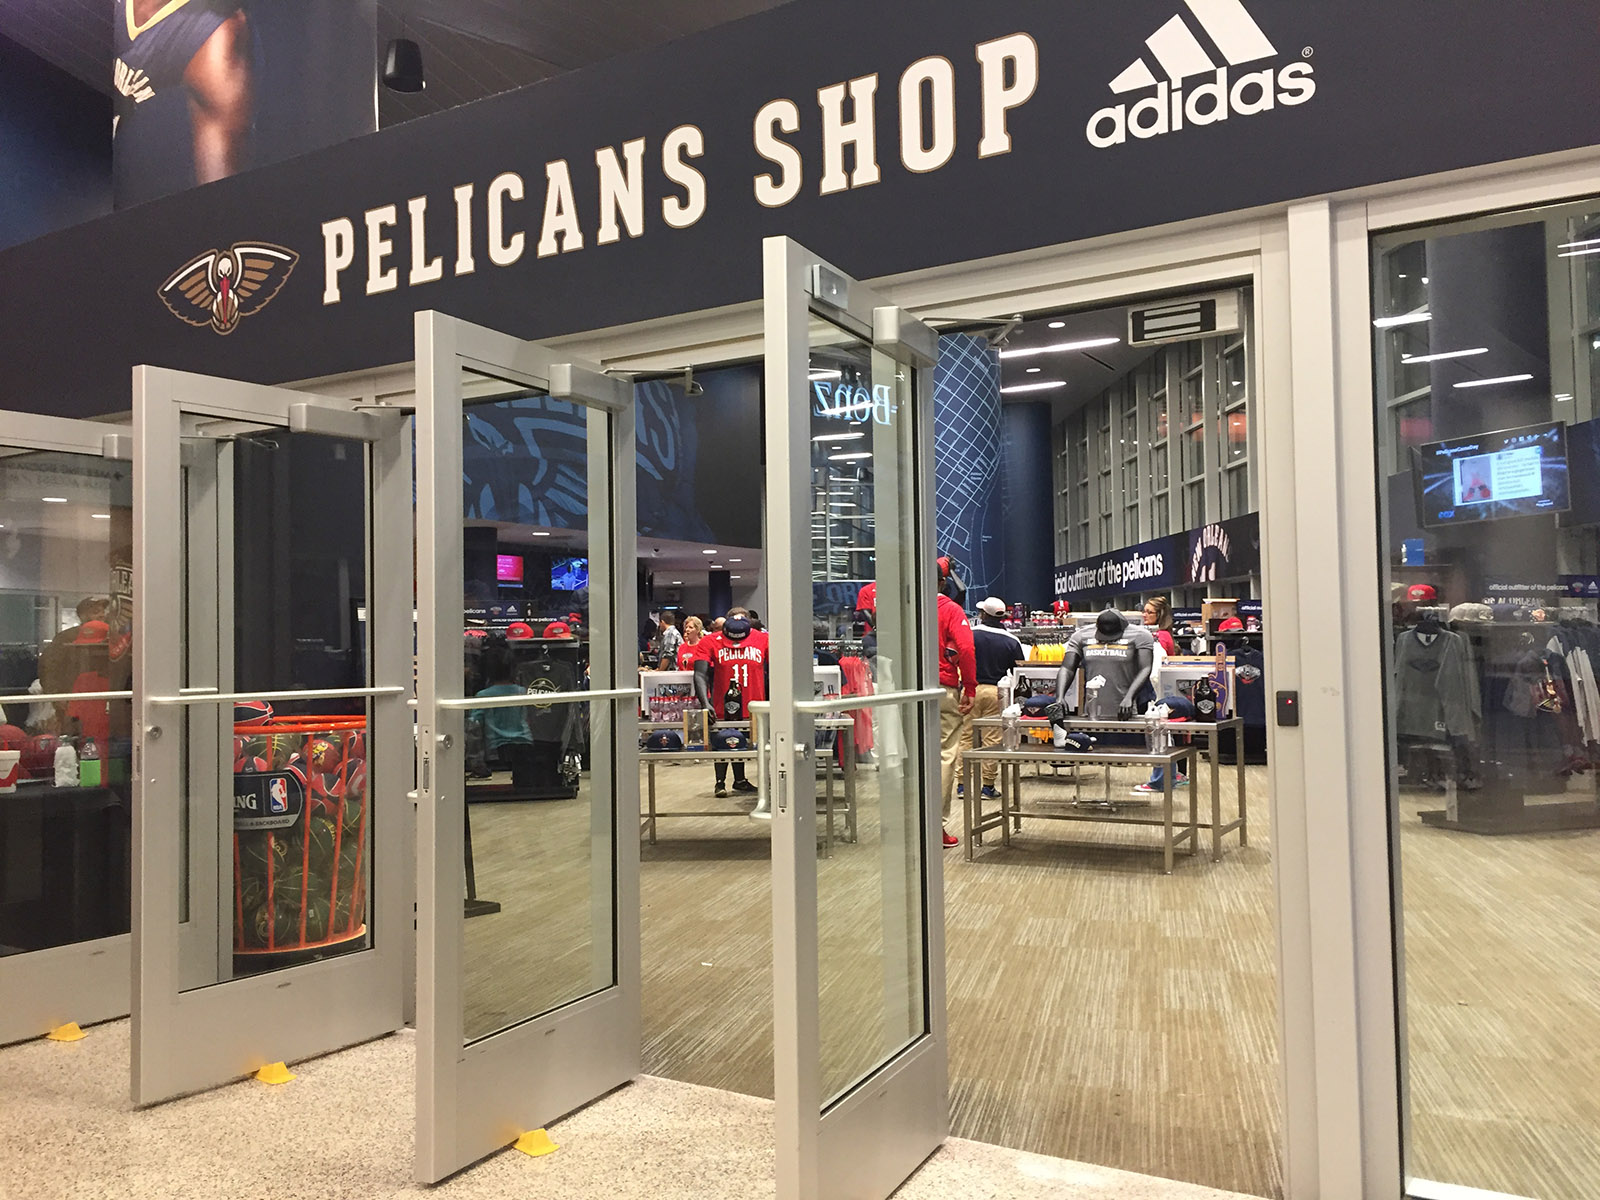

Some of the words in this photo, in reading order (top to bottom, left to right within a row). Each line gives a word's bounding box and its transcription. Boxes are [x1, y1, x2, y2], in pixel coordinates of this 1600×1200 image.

[1086, 61, 1317, 149] adidas
[321, 123, 707, 306] PELICANS
[753, 32, 1040, 208] SHOP
[1068, 567, 1097, 593] outfitter
[1097, 562, 1107, 587] of
[1107, 559, 1122, 584] the
[1122, 552, 1163, 588] pelicans
[718, 646, 762, 664] PELICANS
[732, 663, 749, 688] 11
